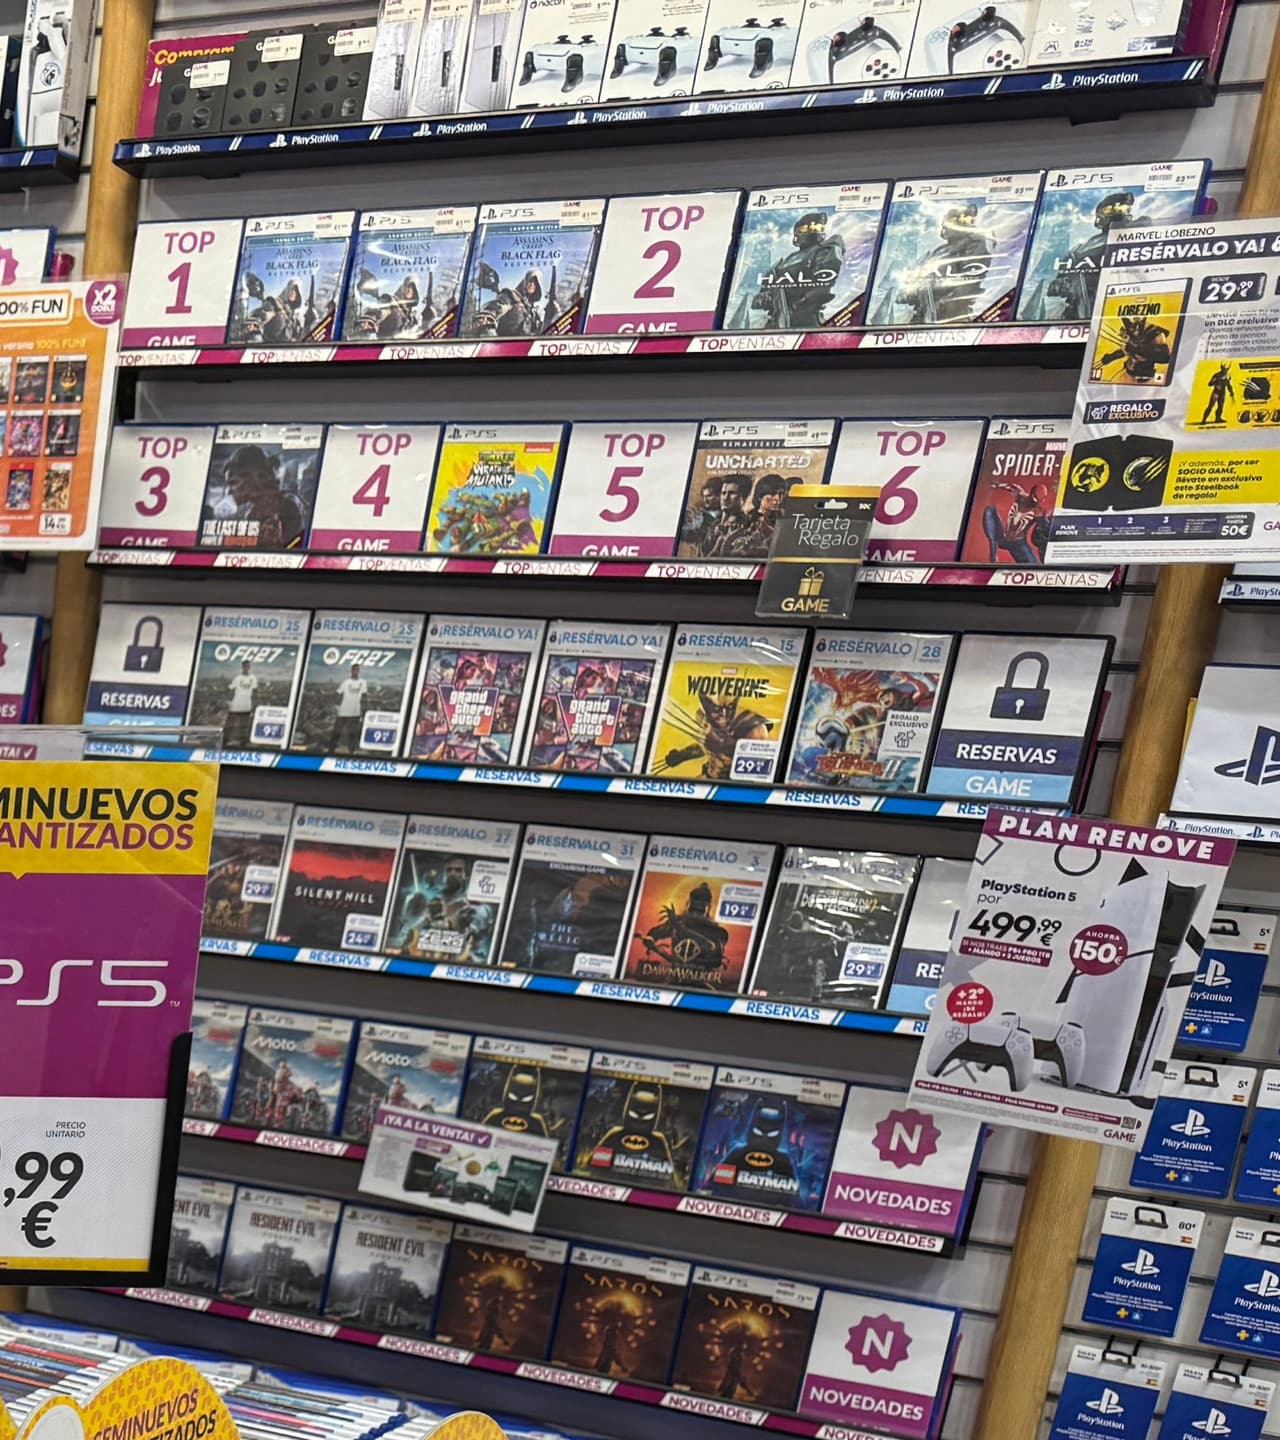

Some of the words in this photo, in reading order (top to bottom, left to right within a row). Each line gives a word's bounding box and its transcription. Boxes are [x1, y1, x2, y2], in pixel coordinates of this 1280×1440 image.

[1073, 72, 1138, 87] PlayStation
[884, 87, 944, 101] PlayStation
[592, 109, 646, 122] PlayStation
[436, 122, 487, 134] PlayStation
[642, 206, 704, 231] TOP
[1165, 227, 1215, 237] LOBEZNO
[164, 232, 215, 254] TOP
[1111, 242, 1228, 264] ¡RESÉRVALO
[1234, 240, 1265, 253] YA!
[635, 241, 682, 298] 2
[166, 262, 192, 314] 1
[32, 299, 63, 313] FUN
[699, 334, 786, 351] TOPVENTAS
[1109, 411, 1159, 419] EXCLUSIVO
[1110, 403, 1152, 412] REGALO
[138, 436, 188, 459] TOP
[357, 432, 412, 456] TOP
[604, 432, 666, 458] TOP
[877, 431, 946, 456] TOP
[706, 454, 812, 471] UNCHARTED
[135, 466, 168, 518] 3
[352, 464, 391, 516] 4
[599, 466, 644, 522] 5
[873, 466, 920, 525] 6
[792, 512, 851, 534] Tarjeta
[1221, 525, 1249, 536] 50€
[798, 529, 859, 549] Regalo
[1002, 571, 1098, 587] TOPVENTAS
[781, 598, 829, 614] GAME
[557, 630, 624, 647] ¡RESÉRVALO
[629, 634, 663, 648] YA!
[828, 636, 912, 656] RESÉRVALO
[688, 675, 769, 698] WOLVERINE
[100, 694, 171, 710] RESERVAS
[956, 744, 1056, 765] RESERVAS
[965, 775, 1032, 796] GAME
[785, 790, 861, 807] RESERVAS
[999, 815, 1080, 842] PLAN
[1088, 827, 1214, 860] RENOVE
[294, 886, 332, 902] SILENT
[344, 889, 375, 904] HILL
[977, 894, 1001, 904] por
[981, 879, 1066, 900] PlayStation
[1067, 892, 1077, 902] 5
[1085, 931, 1120, 941] AHORRA
[46, 1130, 85, 1138] UNITARIO
[56, 1121, 86, 1129] PRECIO
[1104, 1129, 1136, 1143] GAME
[1162, 1138, 1212, 1154] PlayStation
[835, 1184, 952, 1216] NOVEDADES
[844, 1224, 936, 1250] NOVEDADES
[809, 1386, 924, 1421] NOVEDADES
